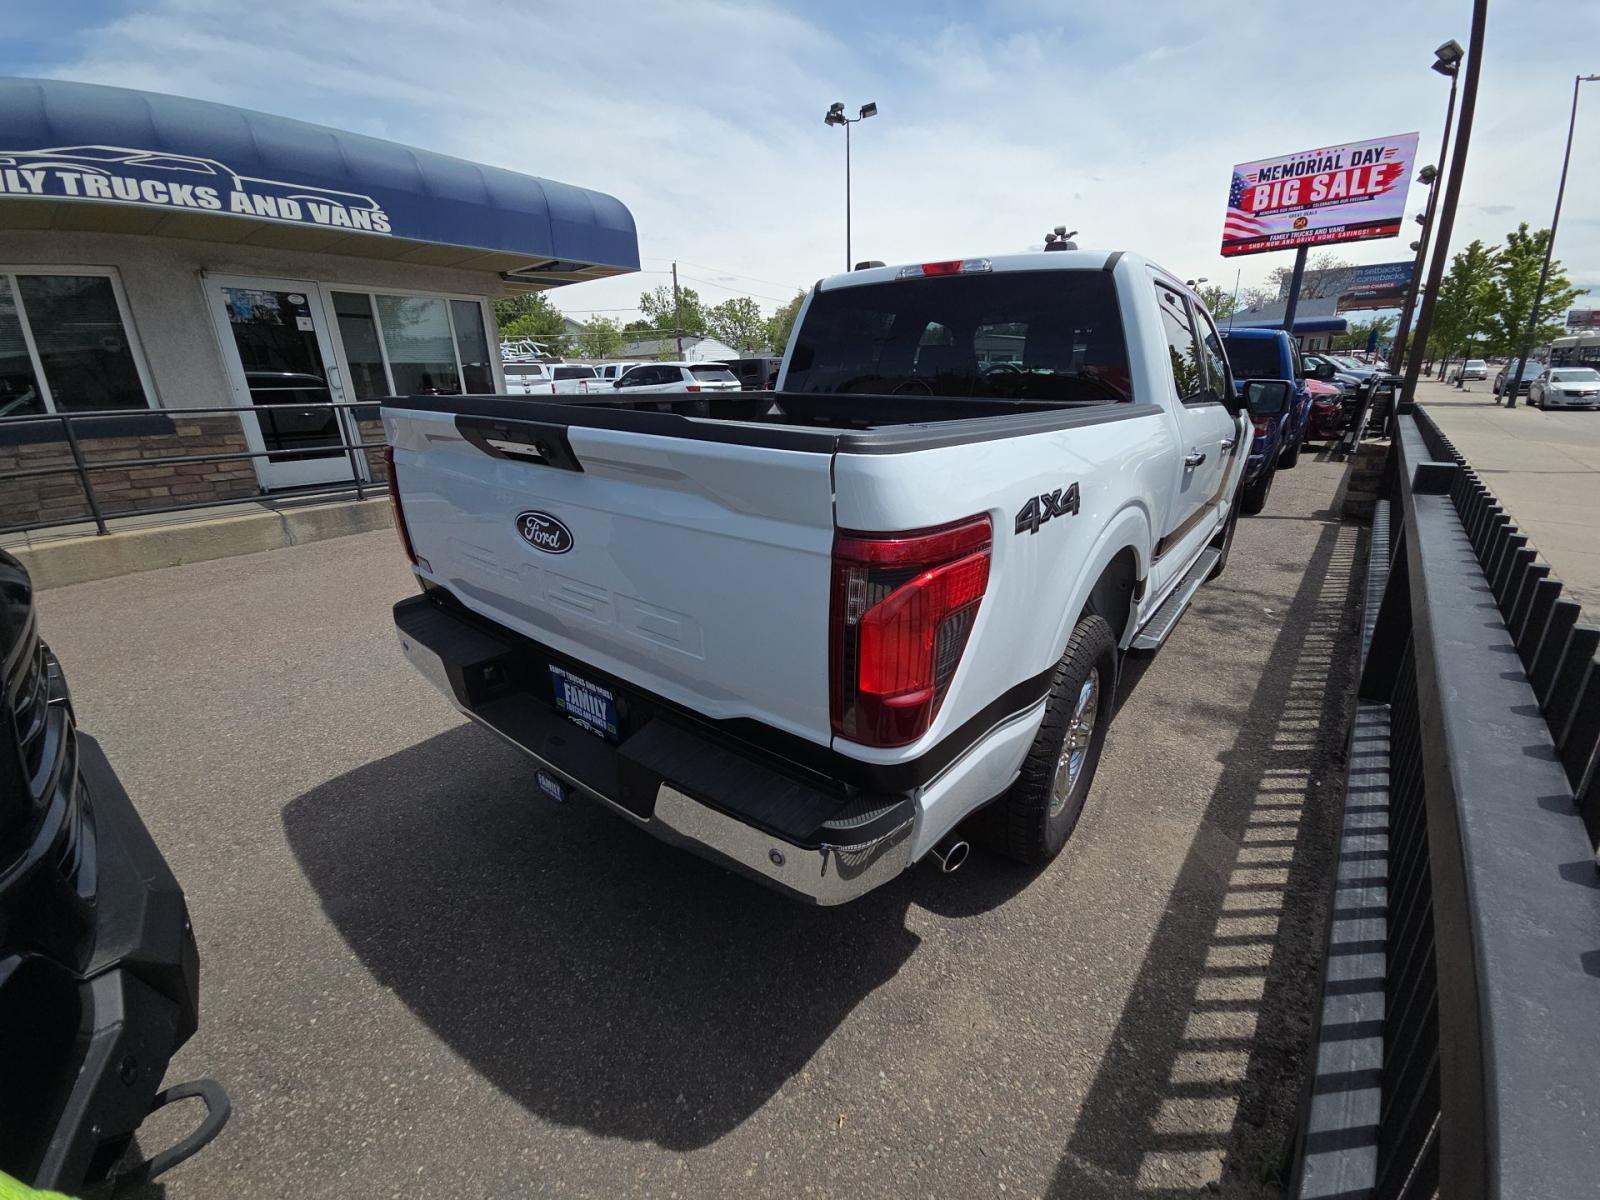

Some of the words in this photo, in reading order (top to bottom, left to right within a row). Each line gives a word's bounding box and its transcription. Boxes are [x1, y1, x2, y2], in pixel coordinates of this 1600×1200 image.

[1258, 155, 1344, 183] MEMORIAL
[1350, 147, 1386, 166] DAY
[56, 170, 222, 210] TRUCKS
[230, 190, 302, 221] AND
[306, 202, 393, 233] VANS
[1252, 179, 1301, 211] BIG
[1310, 166, 1387, 202] SALE
[1248, 241, 1266, 250] SHOP
[1266, 240, 1282, 248] NOW
[1282, 238, 1295, 246] AND
[1296, 235, 1315, 244] DRIVE
[1317, 233, 1336, 241] HOME
[1337, 229, 1370, 239] SAVINGS!
[1269, 232, 1290, 241] FAMILY
[1290, 229, 1313, 239] TRUCKS
[1314, 227, 1328, 236] AND
[1328, 225, 1345, 234] VANS
[1015, 482, 1080, 535] 4x4
[525, 516, 560, 548] Ford
[564, 682, 607, 721] FAMILY
